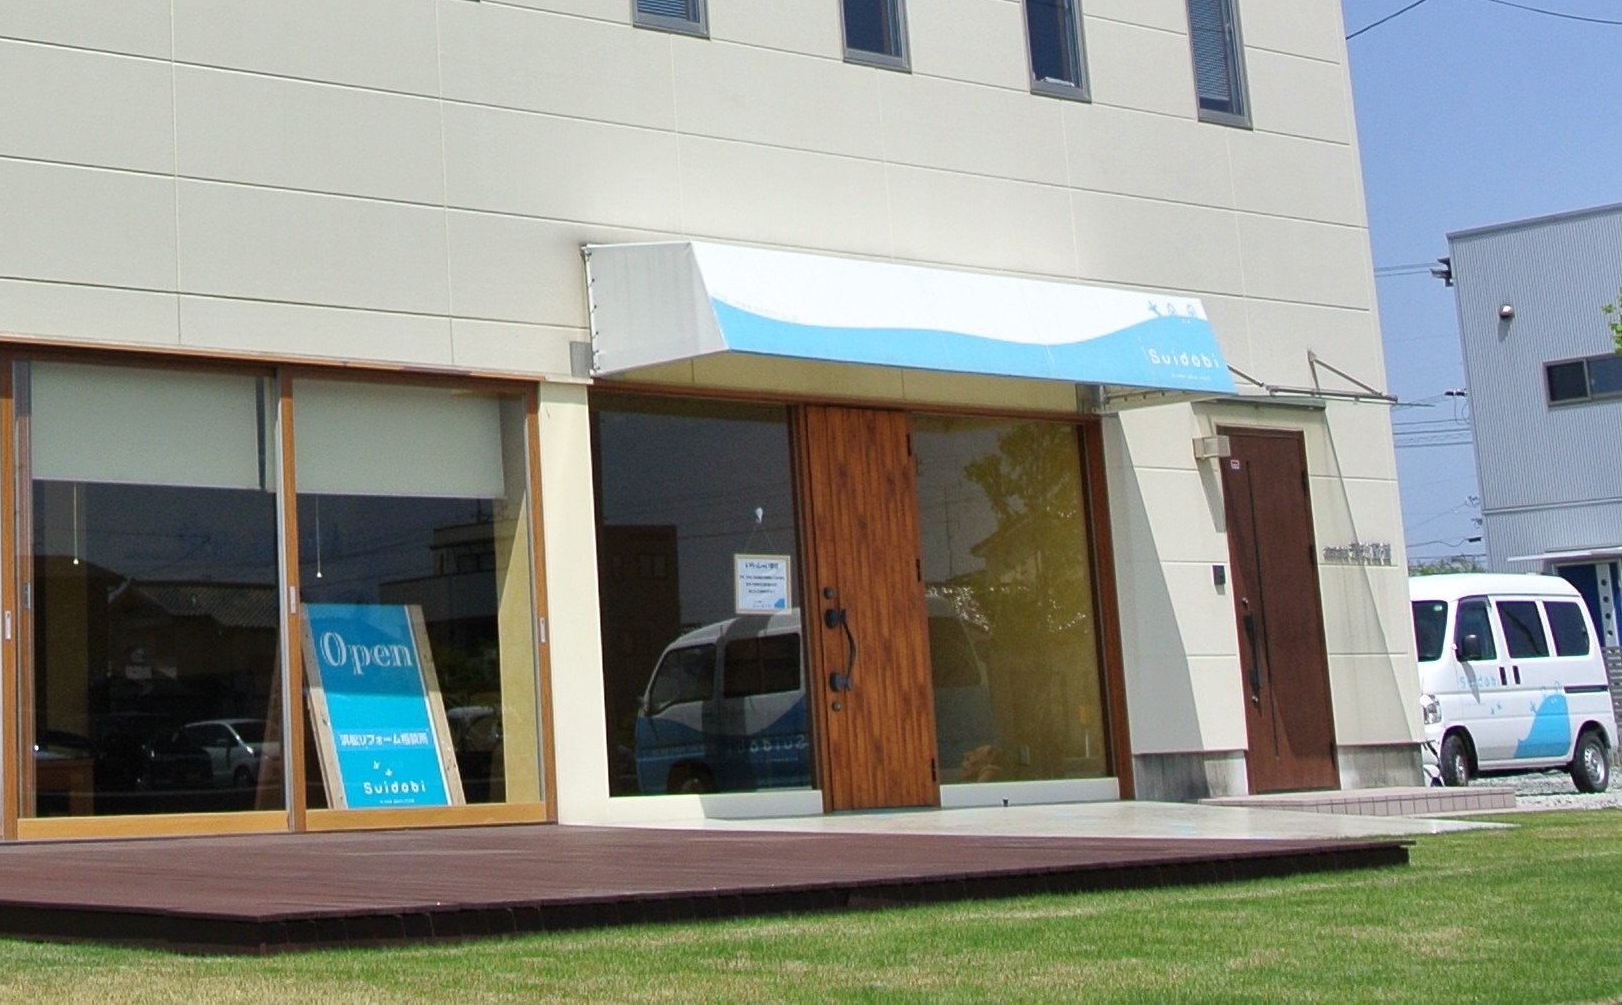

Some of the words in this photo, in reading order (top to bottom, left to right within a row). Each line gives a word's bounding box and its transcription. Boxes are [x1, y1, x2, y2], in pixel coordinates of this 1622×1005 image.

[1148, 348, 1219, 368] Suidobi
[320, 631, 414, 675] Open
[363, 780, 426, 795] Suidobi
